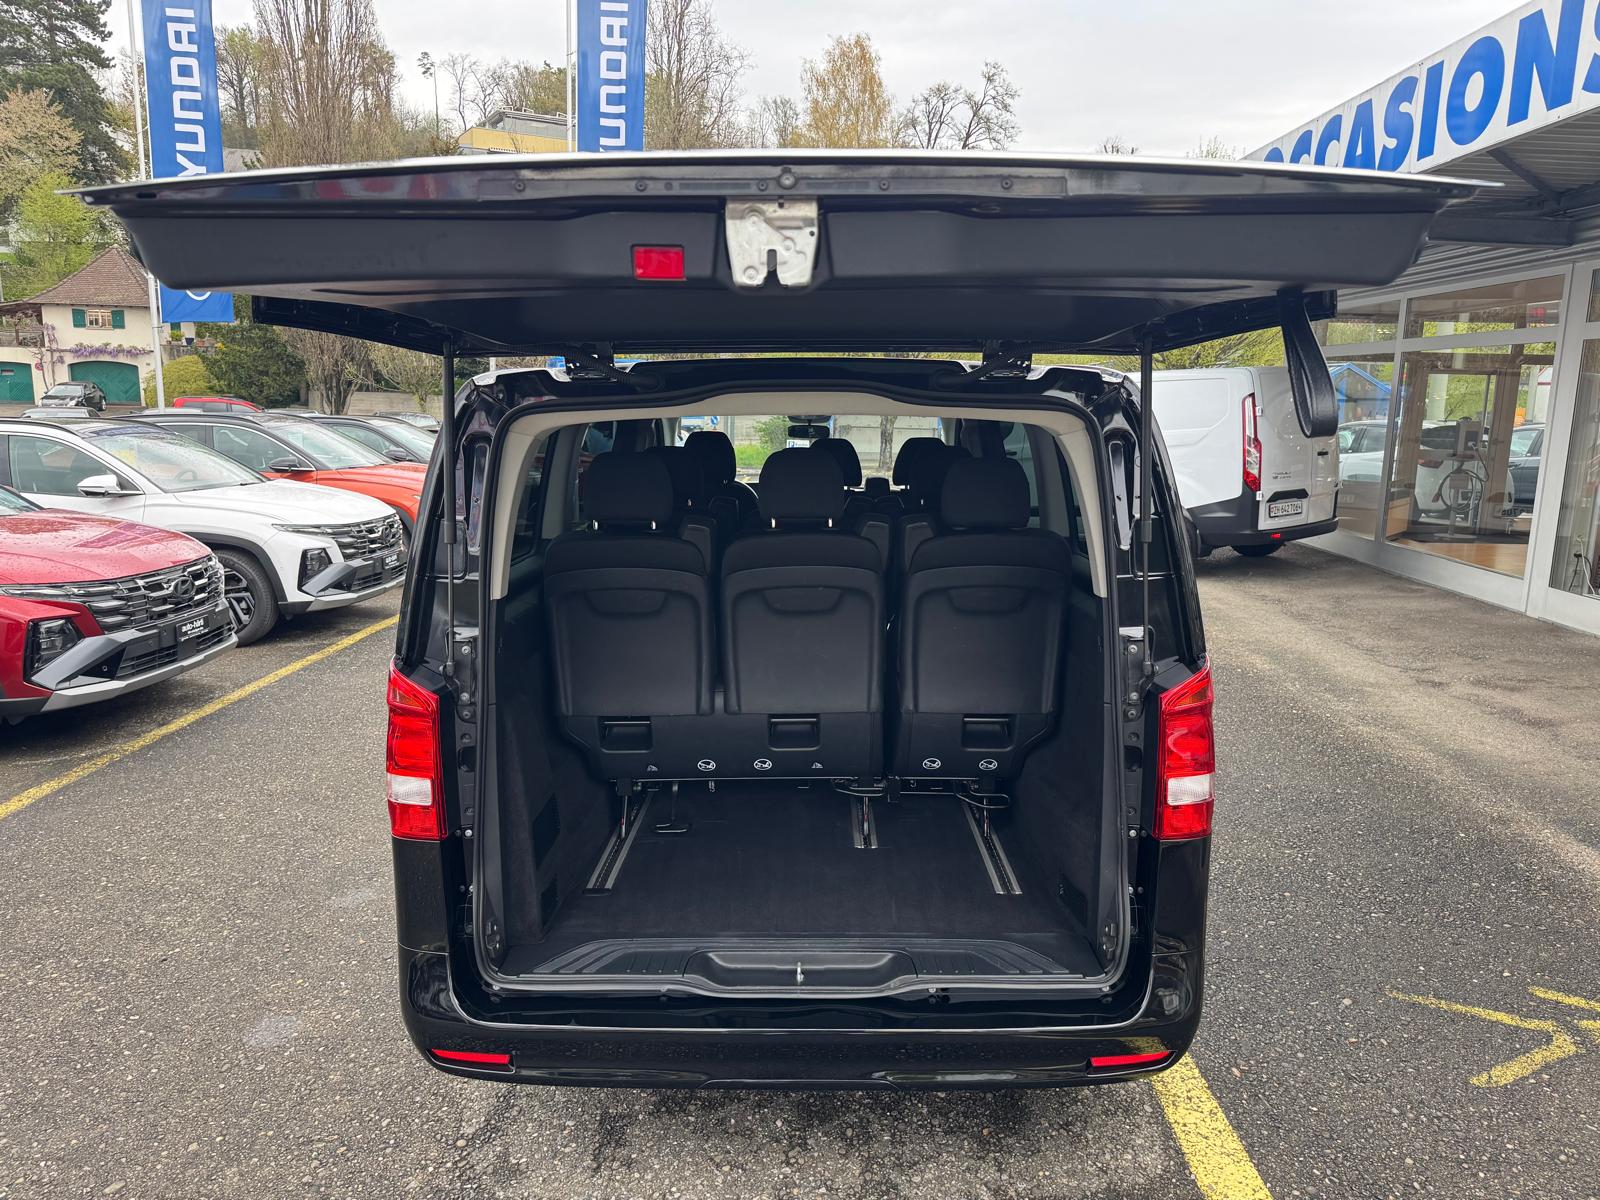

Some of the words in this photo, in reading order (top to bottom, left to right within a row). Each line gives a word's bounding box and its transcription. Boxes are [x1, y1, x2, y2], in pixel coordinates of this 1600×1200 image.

[165, 8, 207, 176] YUNDAI
[600, 2, 629, 151] UNDAI
[1264, 0, 1600, 172] CASION
